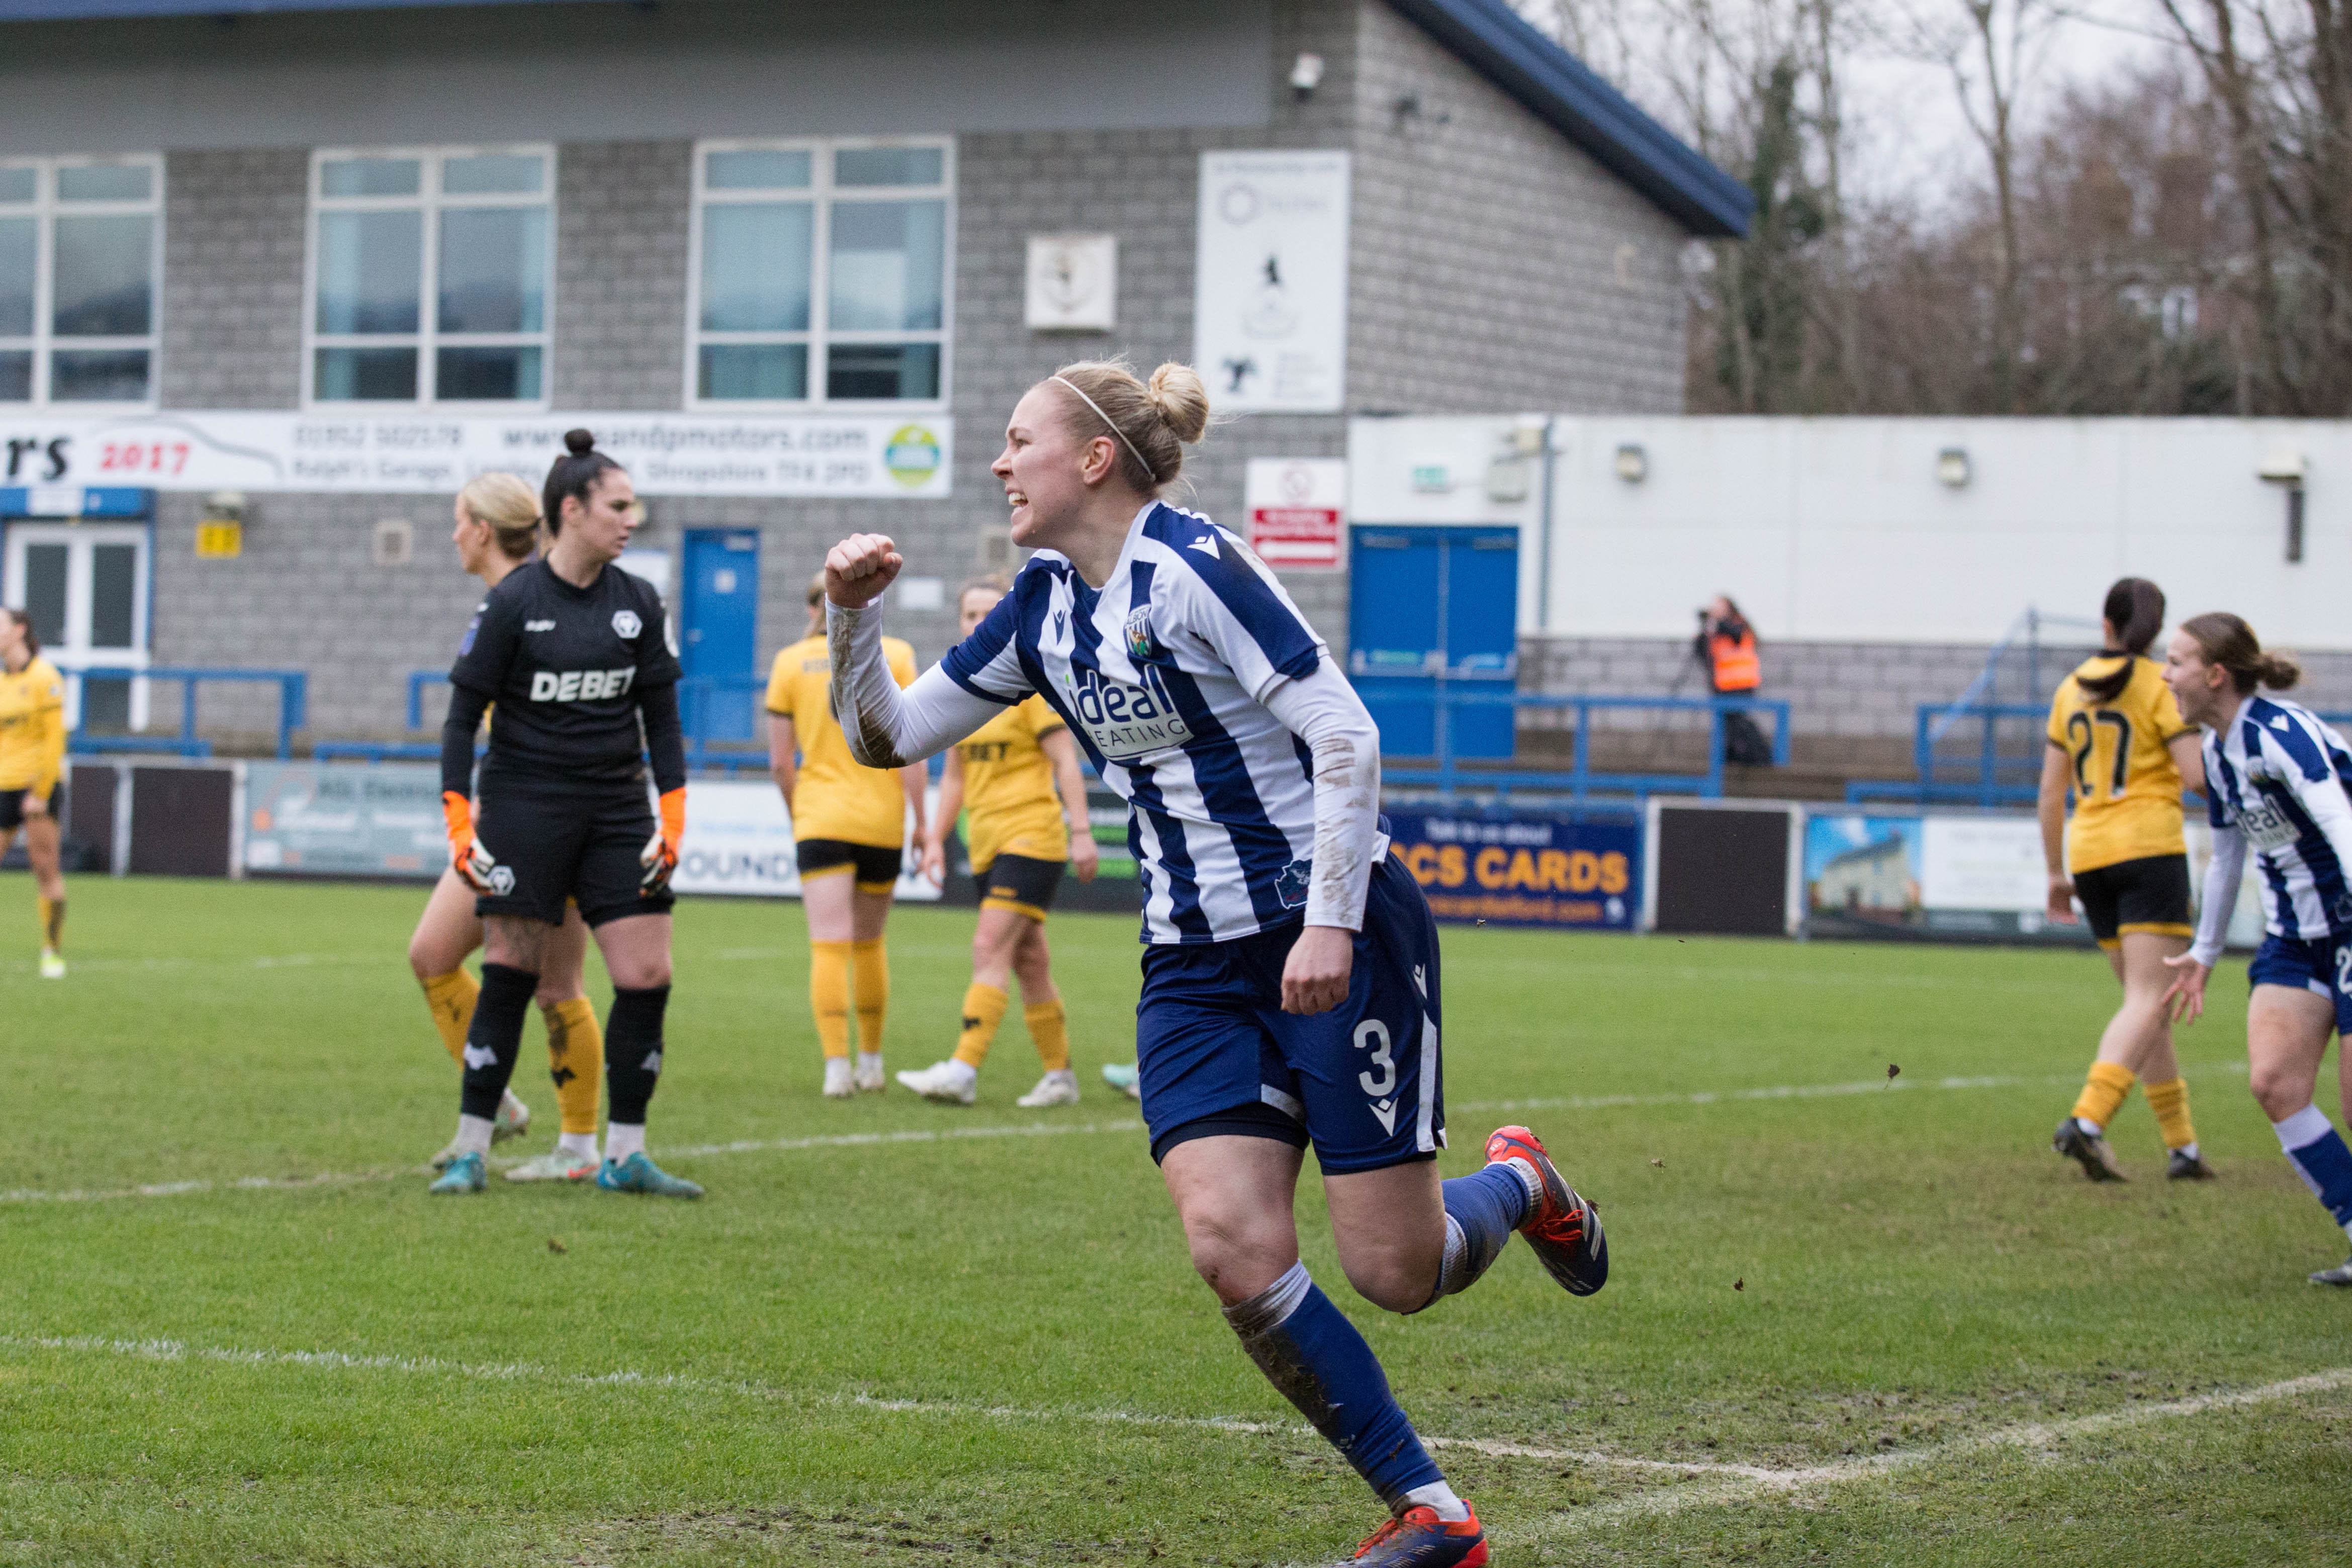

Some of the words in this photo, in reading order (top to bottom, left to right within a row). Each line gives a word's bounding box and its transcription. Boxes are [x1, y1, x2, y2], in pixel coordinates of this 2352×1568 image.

[101, 442, 191, 475] 2017
[530, 666, 636, 701] DEBET
[1065, 664, 1174, 725] ideal
[1090, 719, 1186, 747] EATING
[2067, 710, 2132, 798] 27
[678, 850, 793, 881] OUND
[1474, 846, 1629, 894] CARDS
[2336, 946, 2352, 994] 2
[1353, 1019, 1396, 1096] 3
